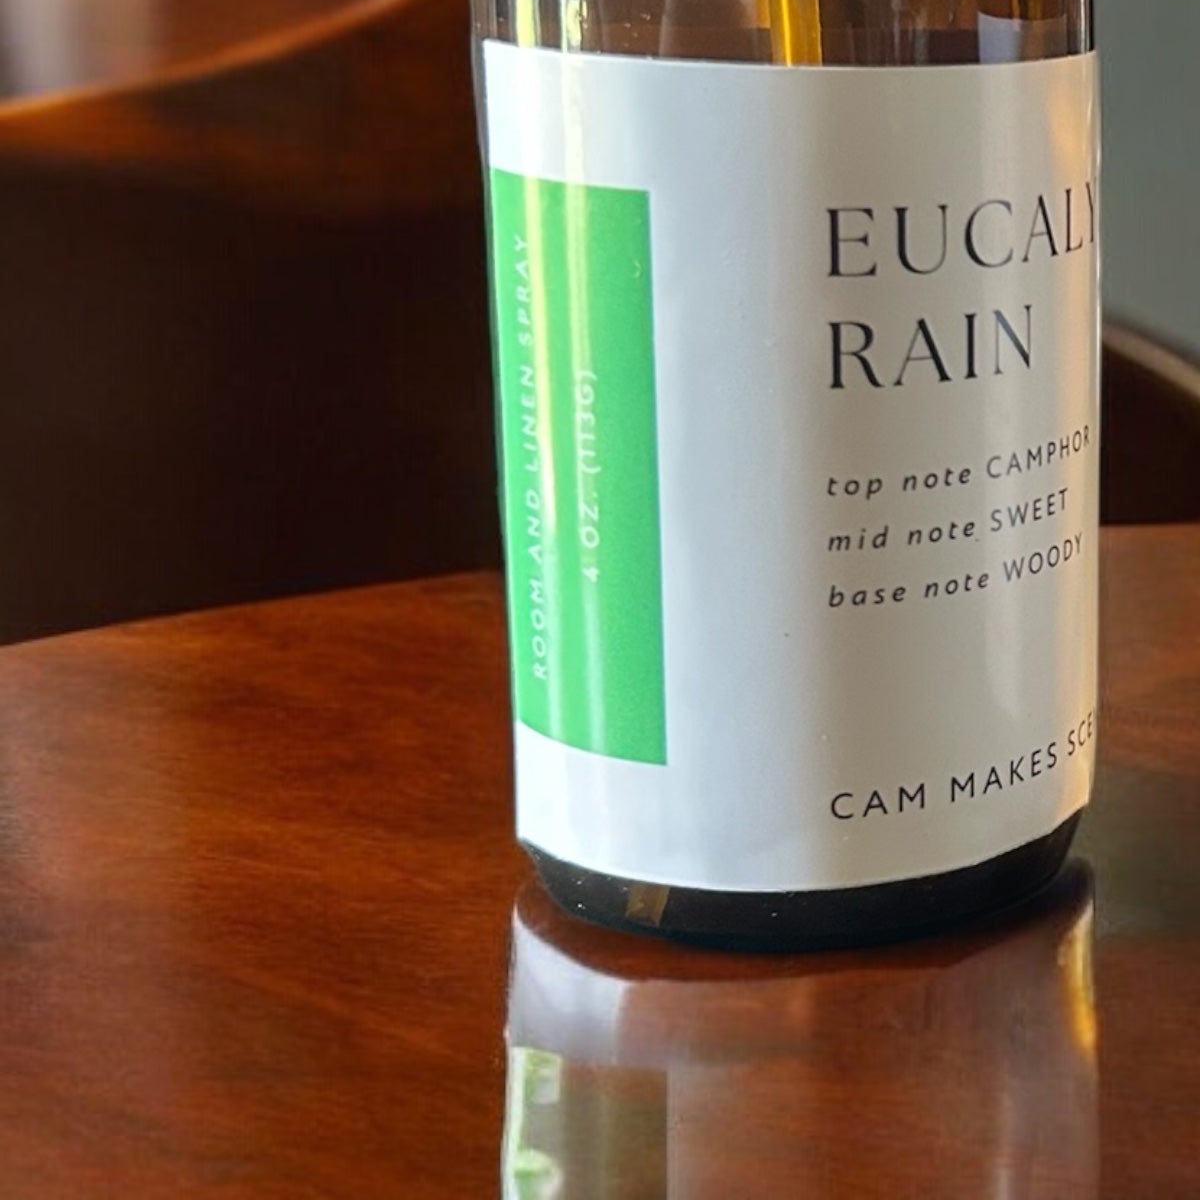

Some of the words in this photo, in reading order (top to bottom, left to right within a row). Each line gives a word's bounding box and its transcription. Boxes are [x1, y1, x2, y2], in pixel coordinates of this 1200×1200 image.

[514, 234, 534, 348] SPRAY
[826, 303, 1034, 390] RAIN
[520, 366, 541, 472] LINEN
[573, 370, 602, 474] (113G)
[826, 477, 883, 501] top
[902, 467, 972, 492] note
[986, 424, 1091, 479] CAMPHOR
[525, 490, 545, 565] AND
[578, 491, 600, 549] OZ.
[827, 525, 889, 552] mid
[907, 521, 976, 546] note
[990, 487, 1068, 532] SWEET
[582, 566, 600, 583] 4
[828, 584, 907, 608] base
[923, 573, 990, 599] note
[1003, 535, 1083, 582] WOODY
[530, 578, 548, 679] ROOM
[829, 782, 926, 821] CAM
[950, 741, 1058, 804] MAKES
